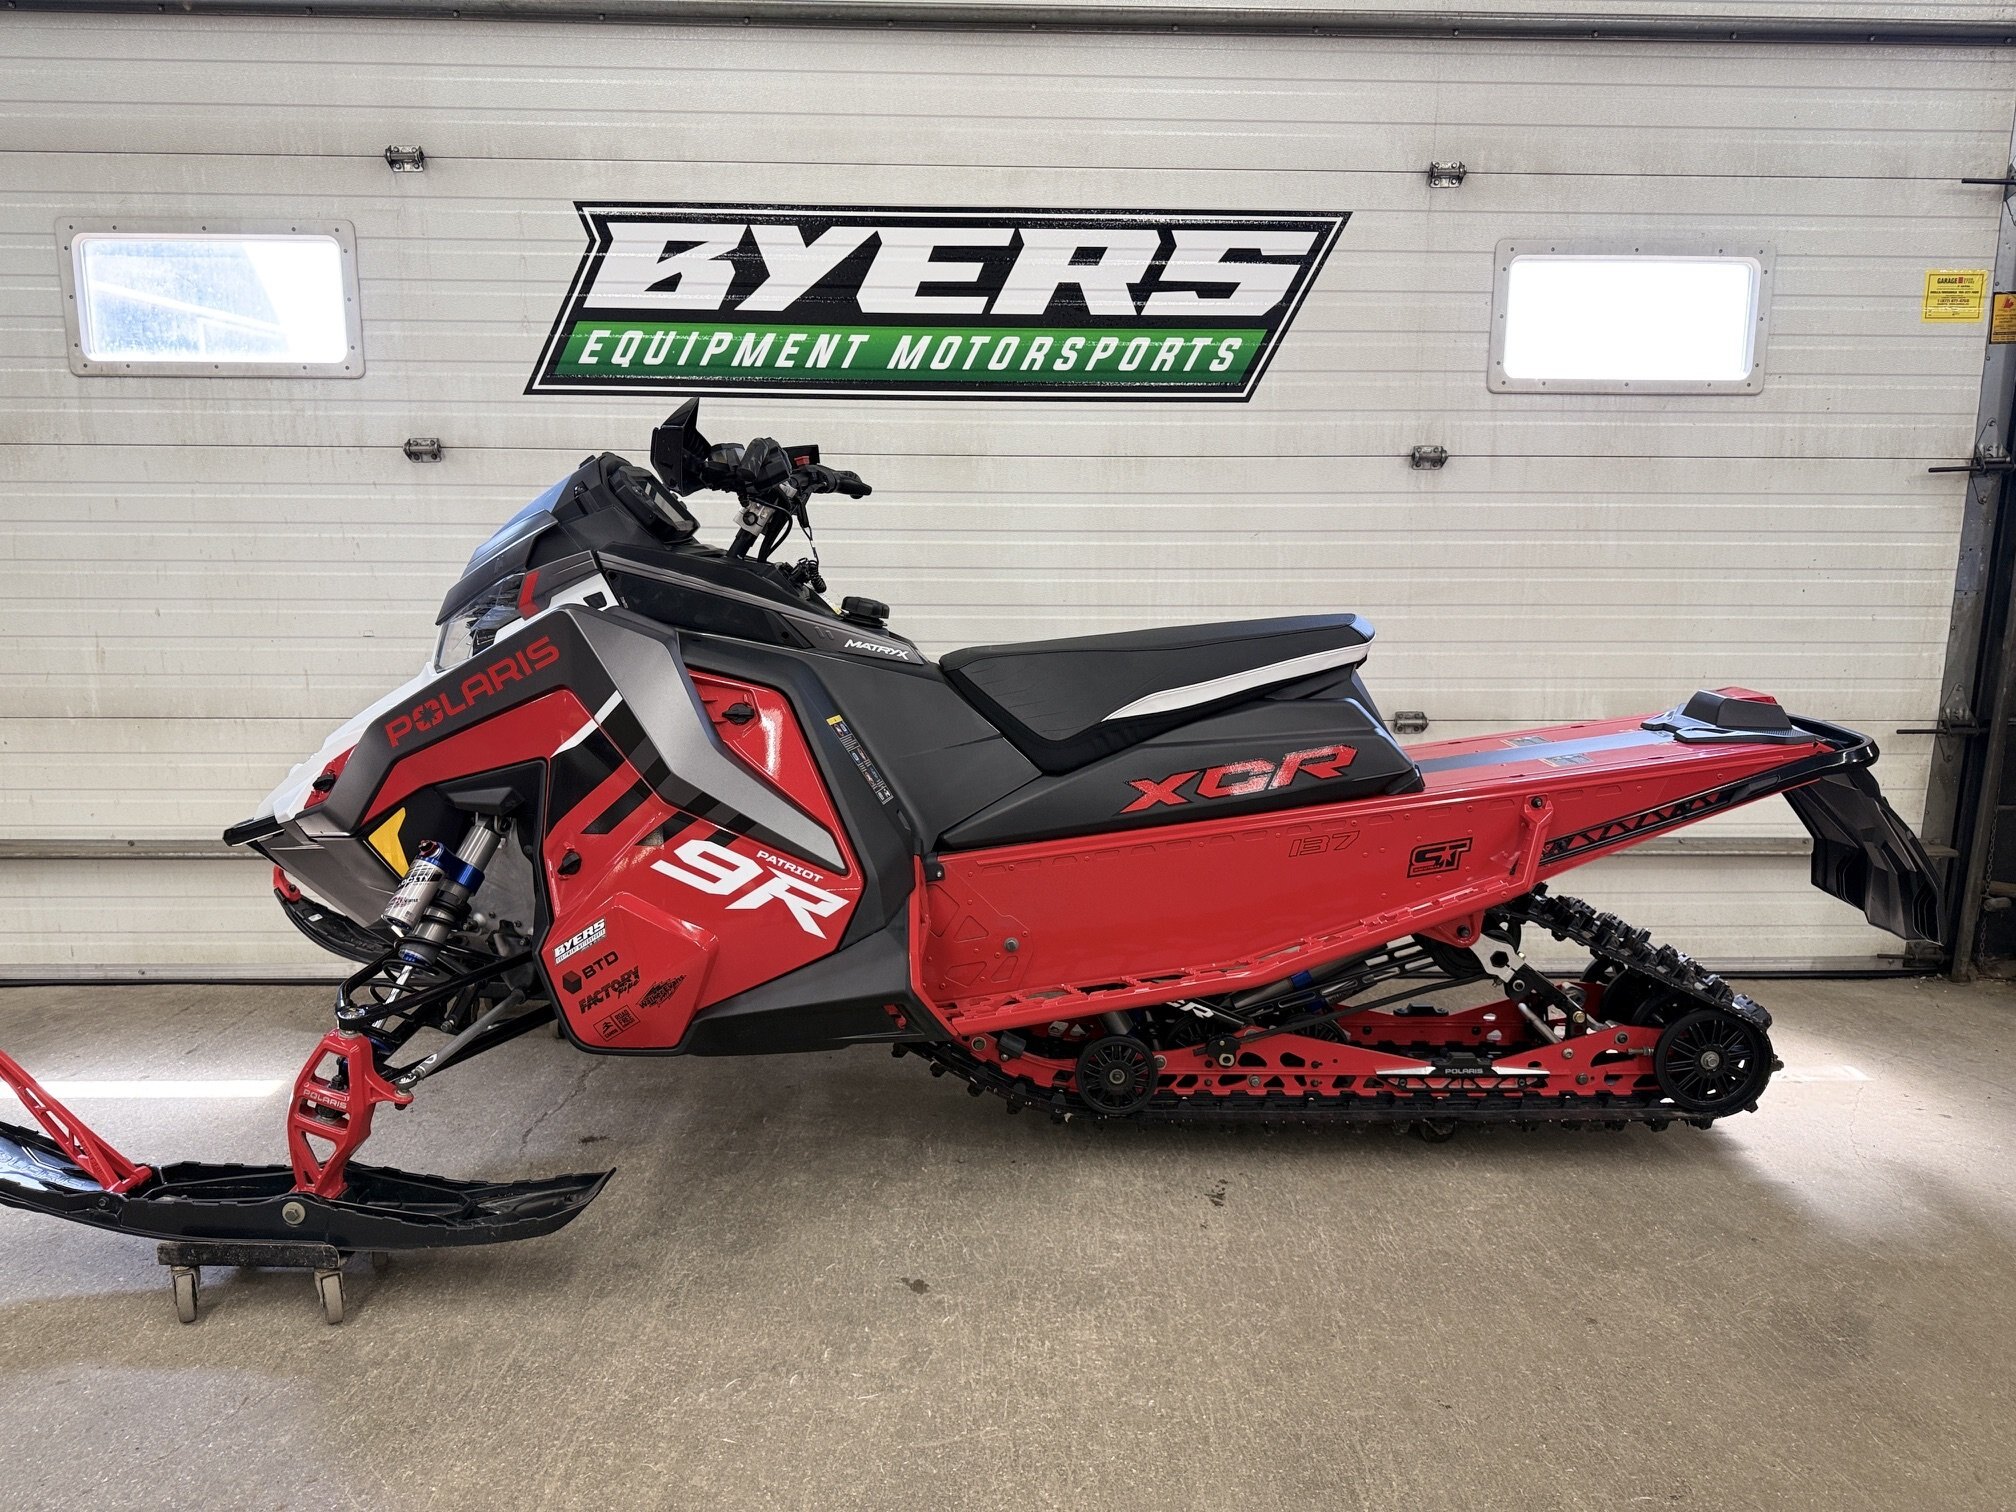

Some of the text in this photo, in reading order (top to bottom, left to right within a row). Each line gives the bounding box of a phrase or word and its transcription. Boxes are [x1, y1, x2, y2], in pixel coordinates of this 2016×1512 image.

[582, 222, 1318, 316] BYERS
[578, 332, 1245, 373] EQUIPMENT MOTORSPORTS
[844, 638, 910, 661] MATRYX
[384, 635, 560, 748] POLARIS
[1119, 744, 1358, 814] XCR
[1288, 830, 1360, 857] 137
[756, 850, 823, 883] PATRIOT
[650, 839, 850, 940] 9R
[554, 918, 605, 957] BYERS
[582, 950, 619, 979] BTD
[578, 965, 640, 1014] FACTORY
[1445, 1067, 1483, 1075] POLARIS
[303, 1089, 347, 1109] POLARIS
